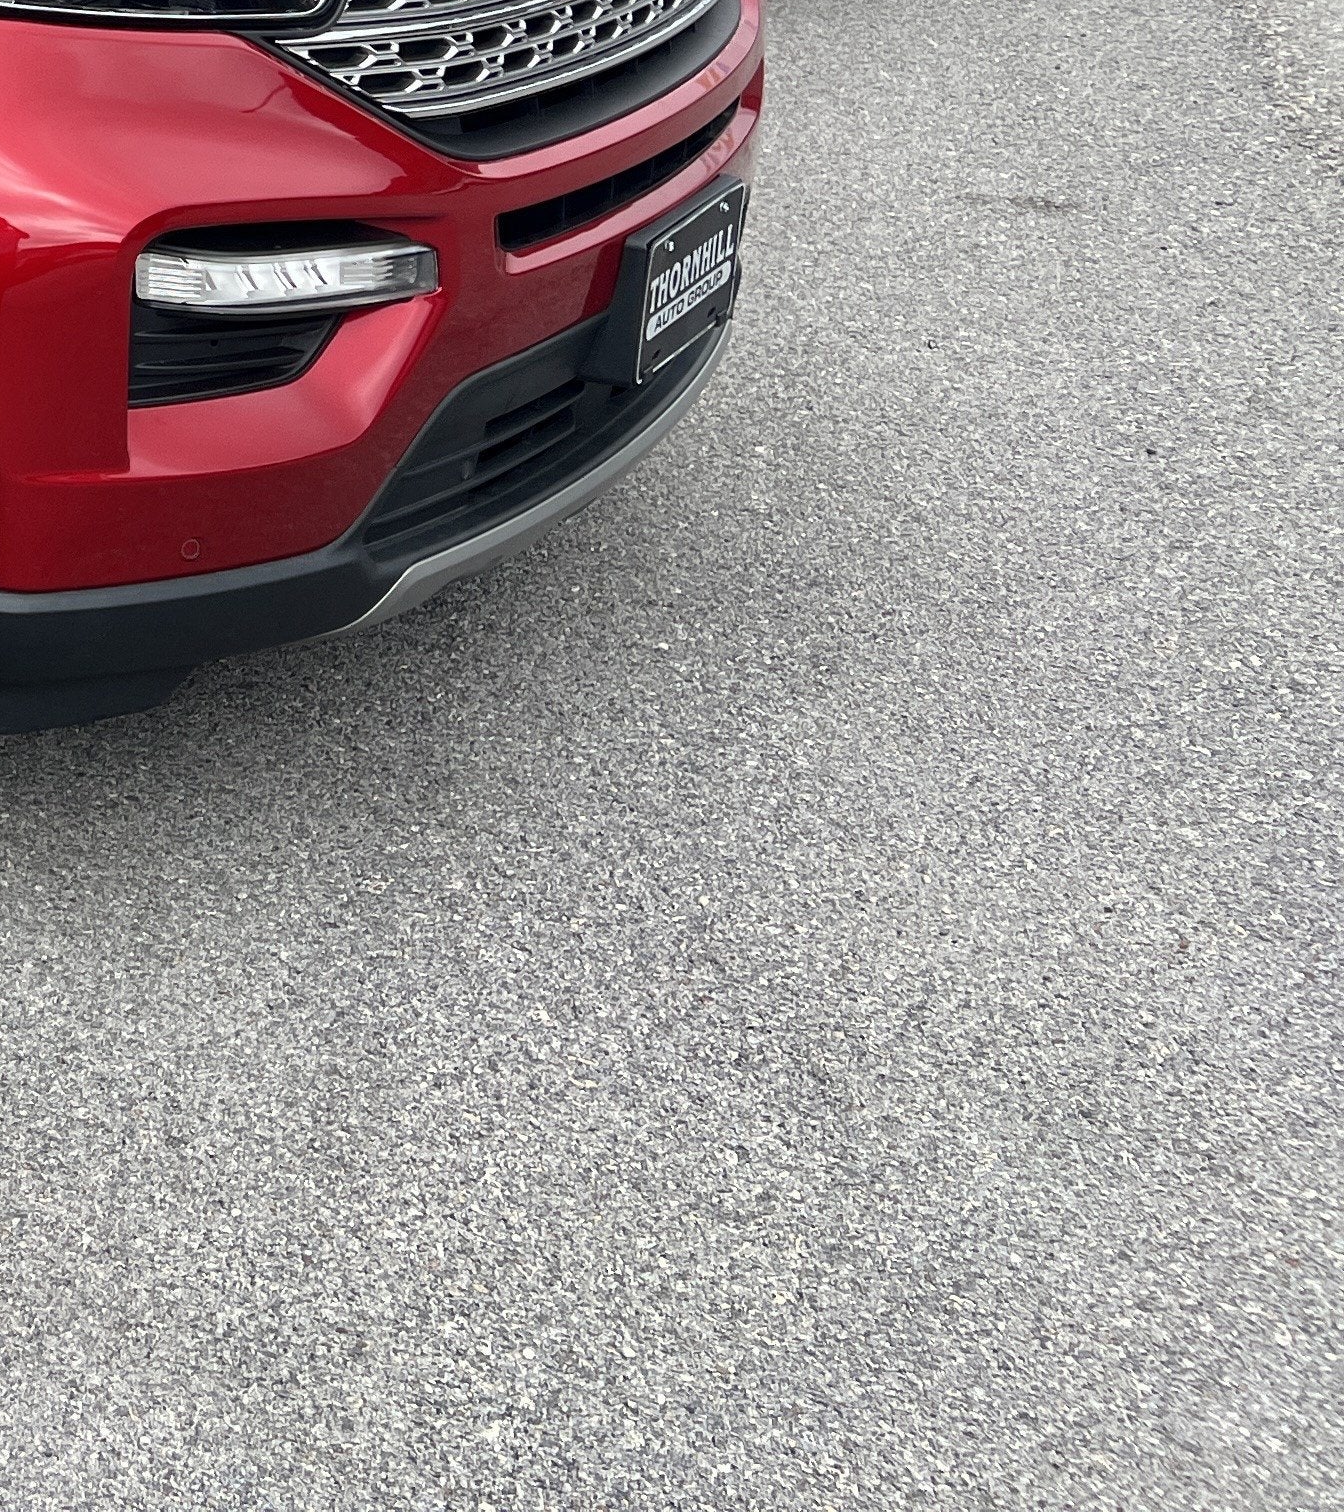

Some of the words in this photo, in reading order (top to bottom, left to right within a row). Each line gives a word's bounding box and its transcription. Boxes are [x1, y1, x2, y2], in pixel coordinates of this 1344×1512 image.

[649, 223, 734, 314] THORNHILL
[653, 299, 685, 333] AUTO
[687, 269, 723, 307] GROUP
